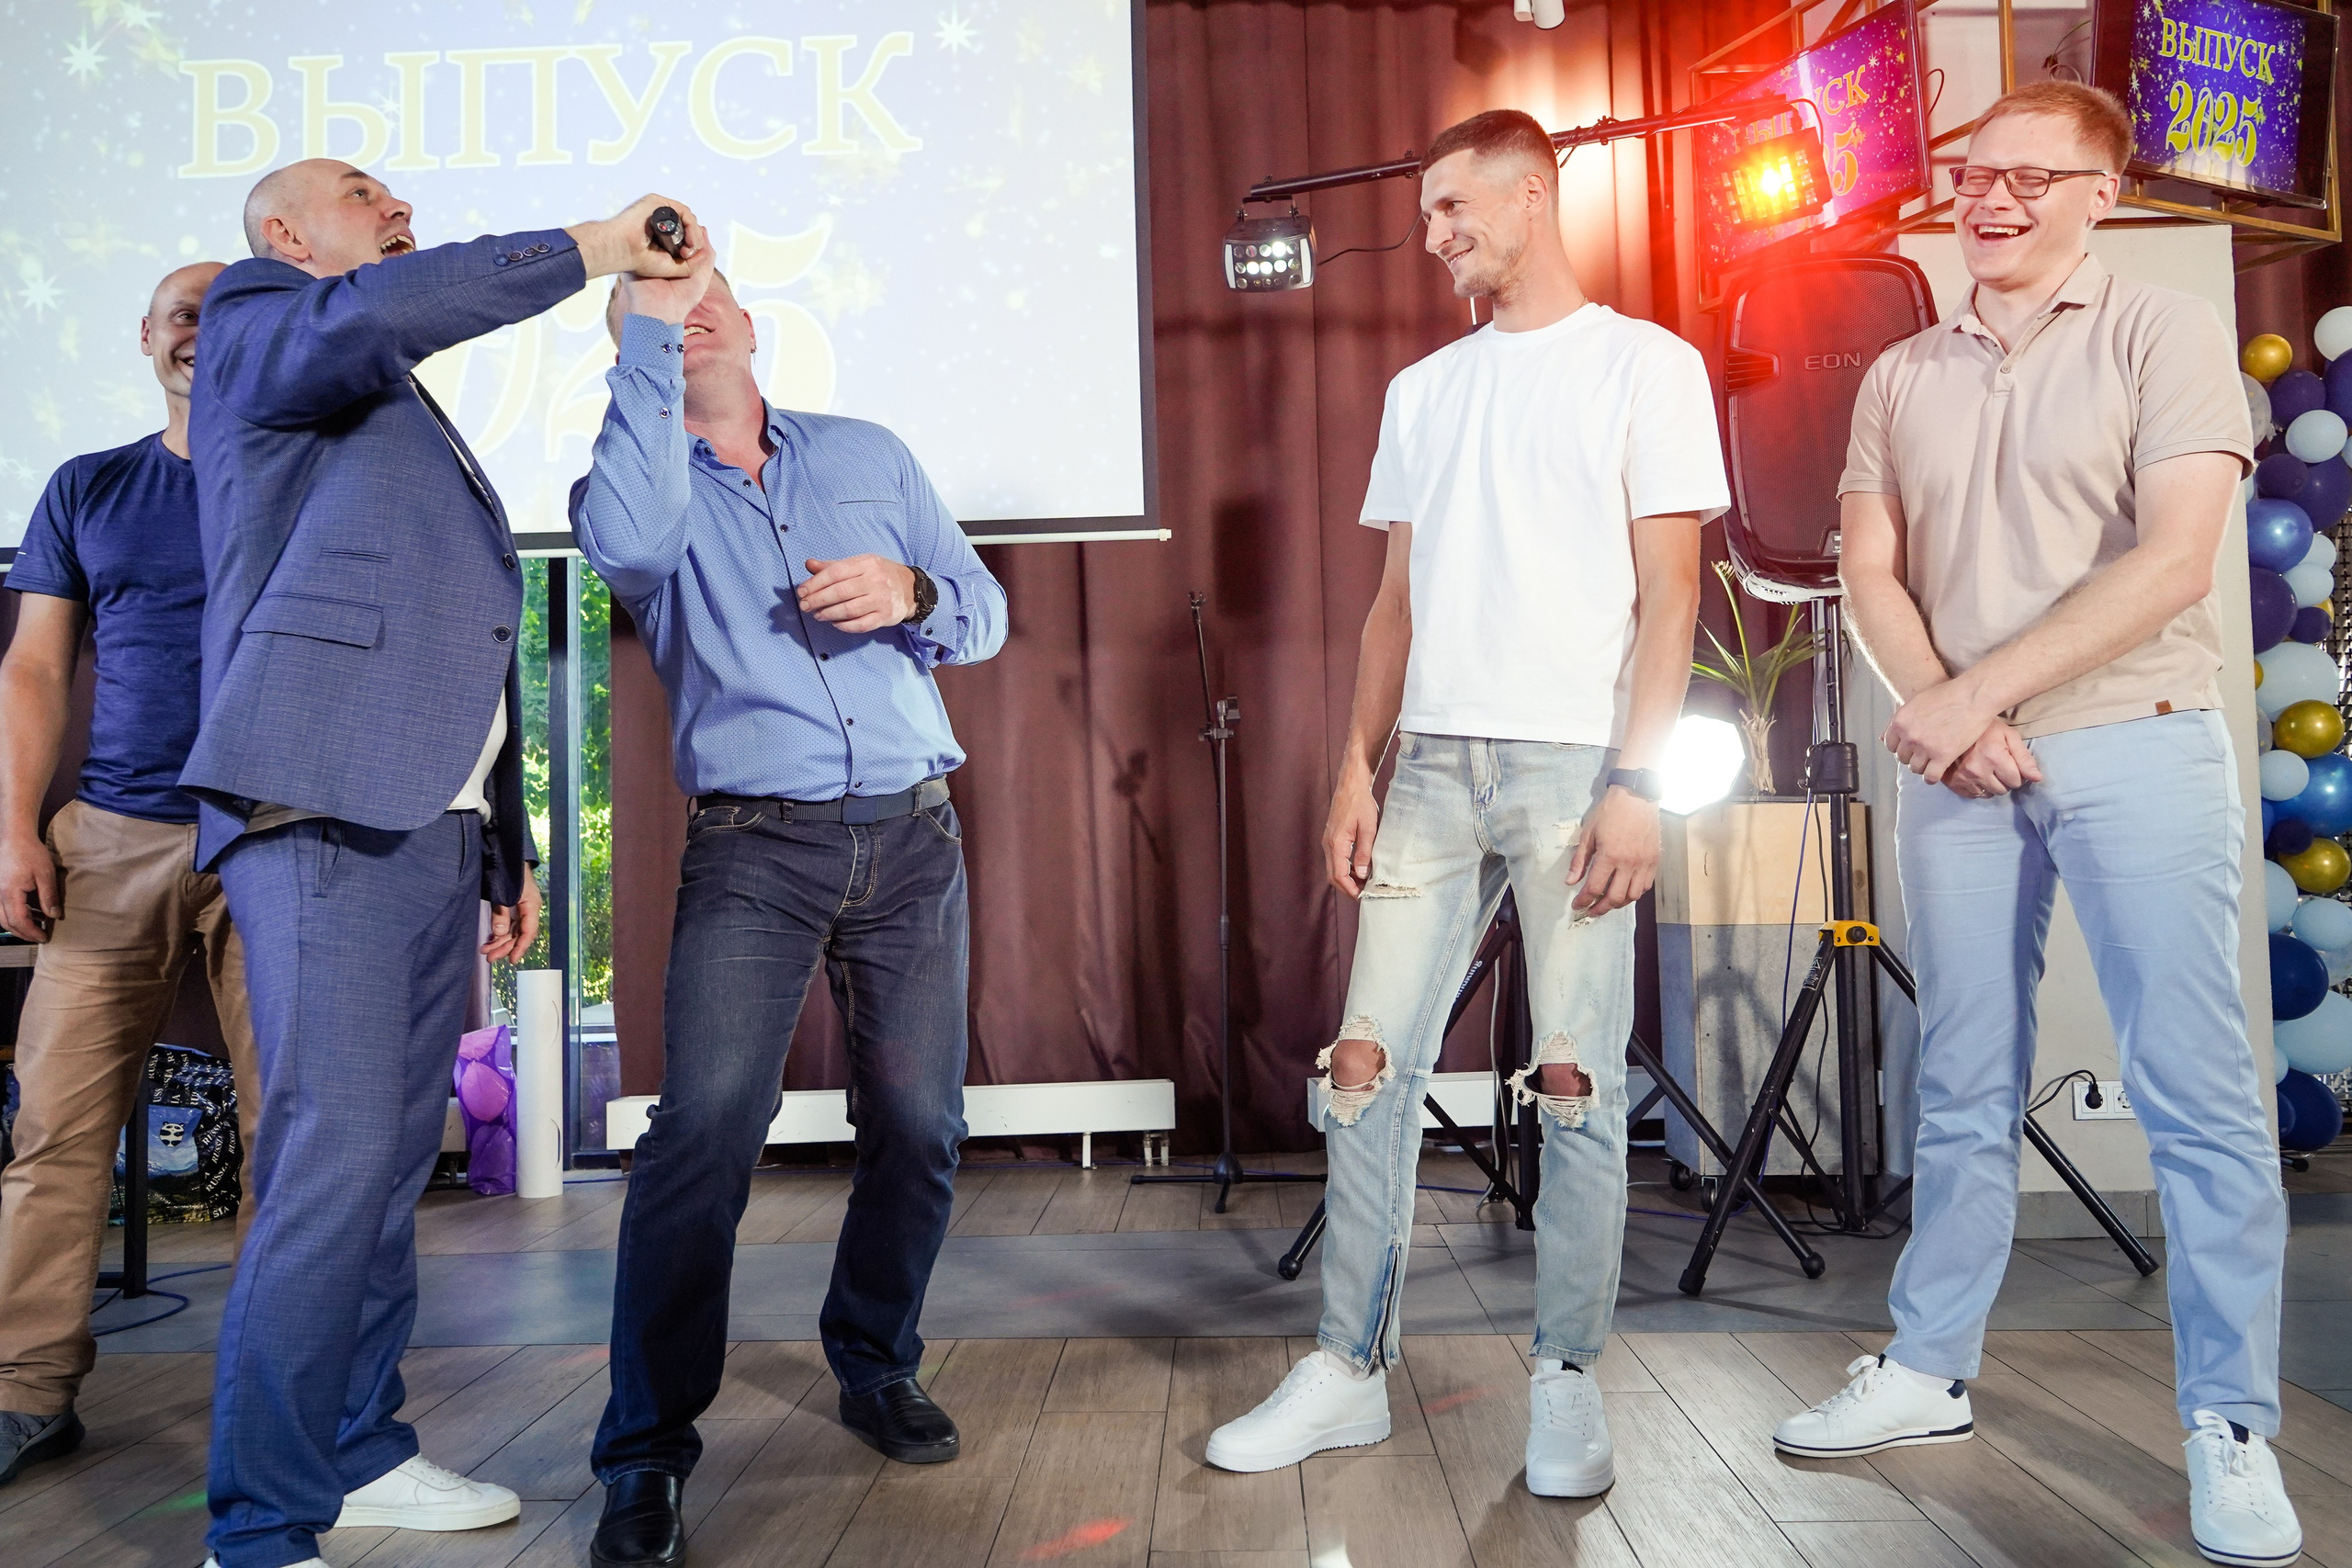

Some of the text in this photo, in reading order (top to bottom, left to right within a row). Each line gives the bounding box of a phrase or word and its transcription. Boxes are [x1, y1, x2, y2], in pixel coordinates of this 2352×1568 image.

[2159, 17, 2276, 85] ВЫПУСК
[177, 31, 923, 178] ВЫПУСК
[2165, 81, 2261, 167] 2025
[1804, 352, 1861, 370] EON
